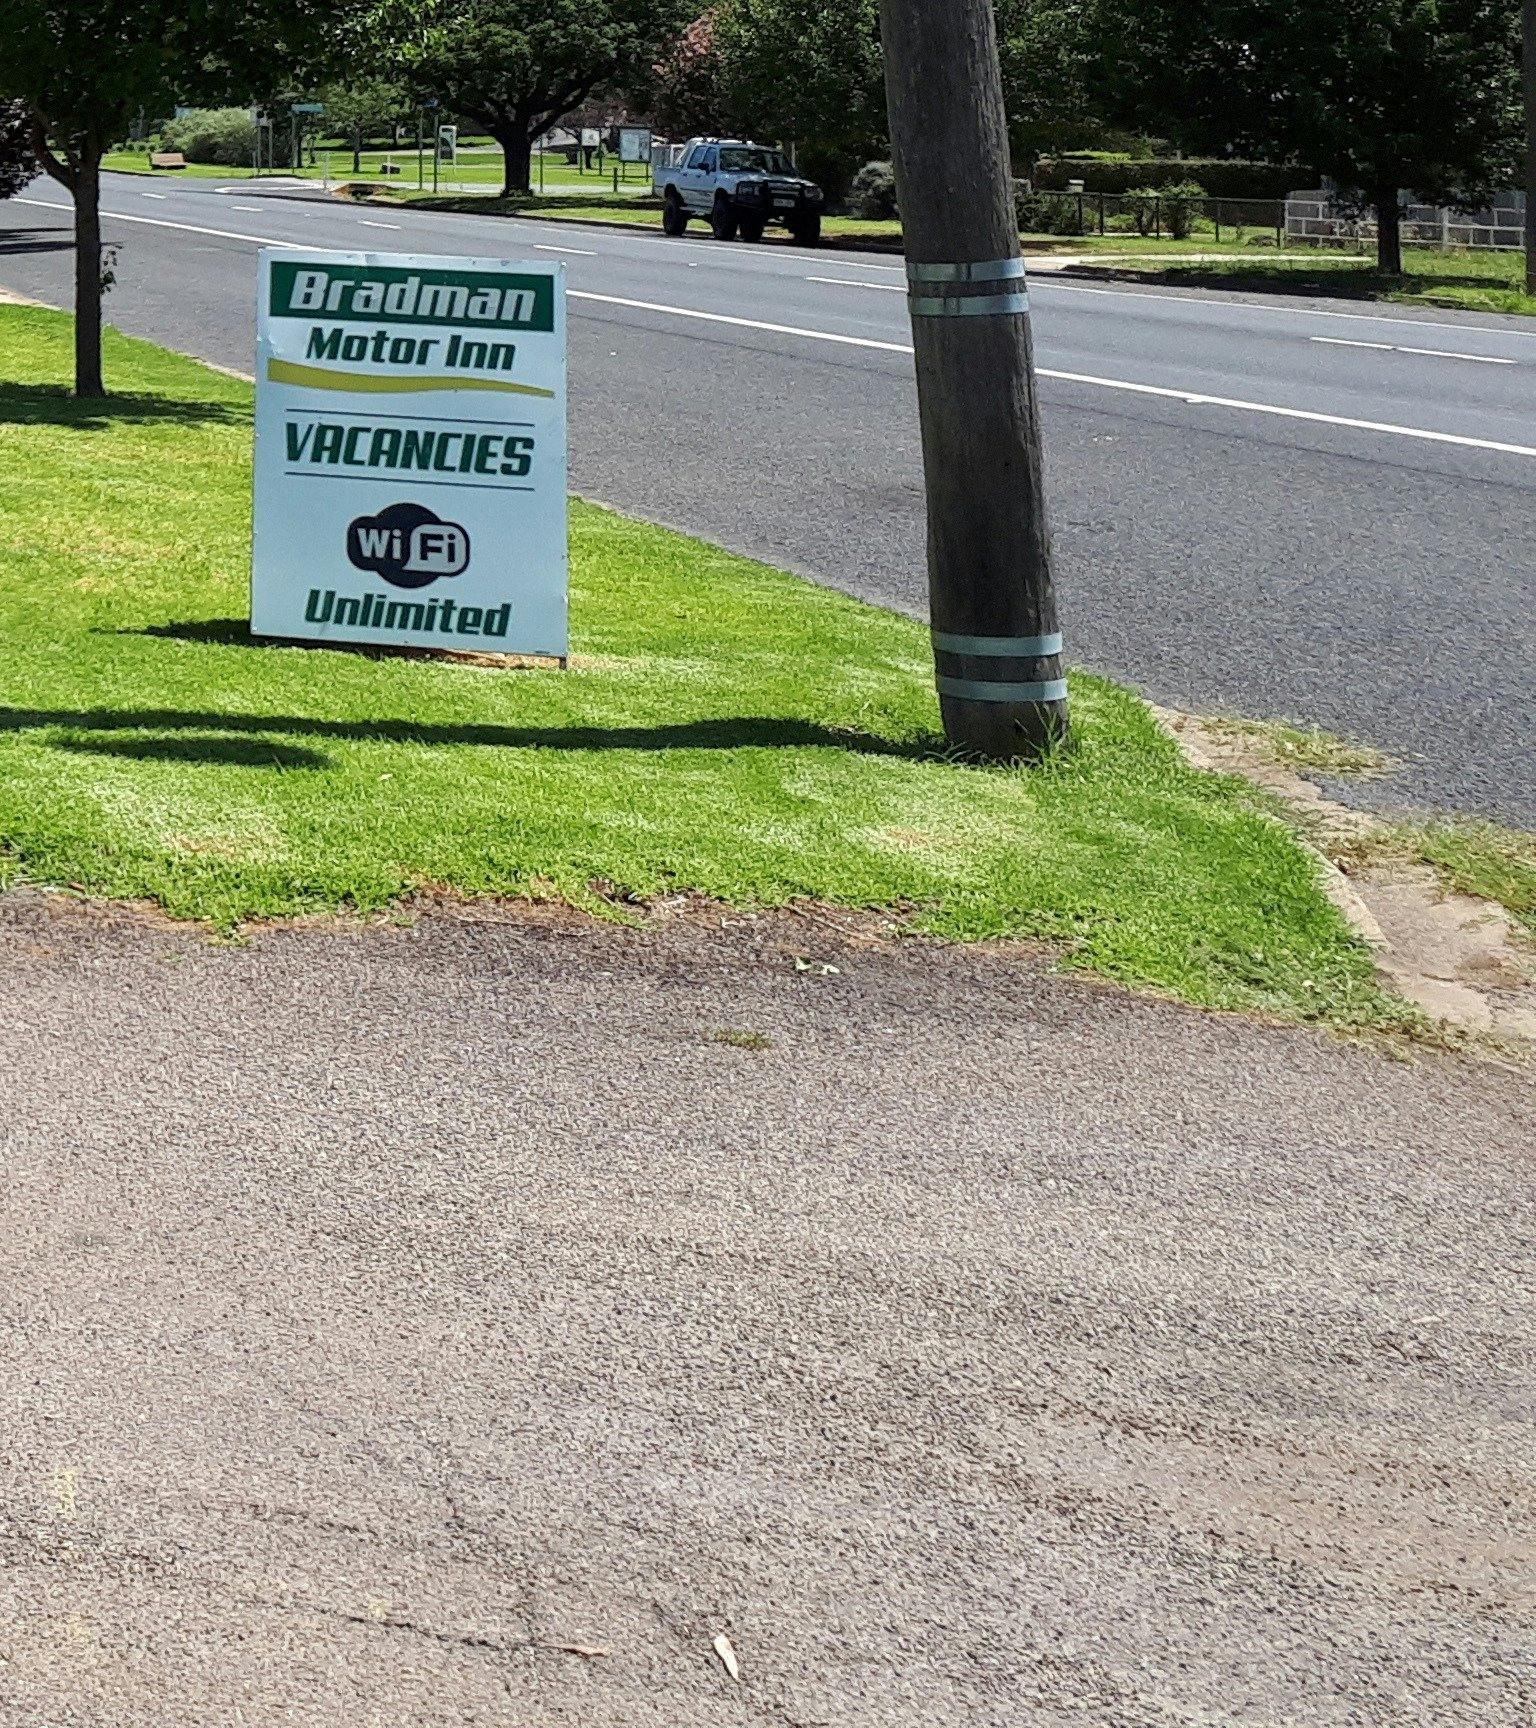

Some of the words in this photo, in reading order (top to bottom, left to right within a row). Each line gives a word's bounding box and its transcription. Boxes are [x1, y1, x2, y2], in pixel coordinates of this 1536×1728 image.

[289, 271, 536, 322] Bradman
[305, 327, 439, 365] Motor
[445, 335, 516, 371] Inn
[286, 422, 535, 477] VACANCIES
[304, 590, 511, 637] Unlimited
